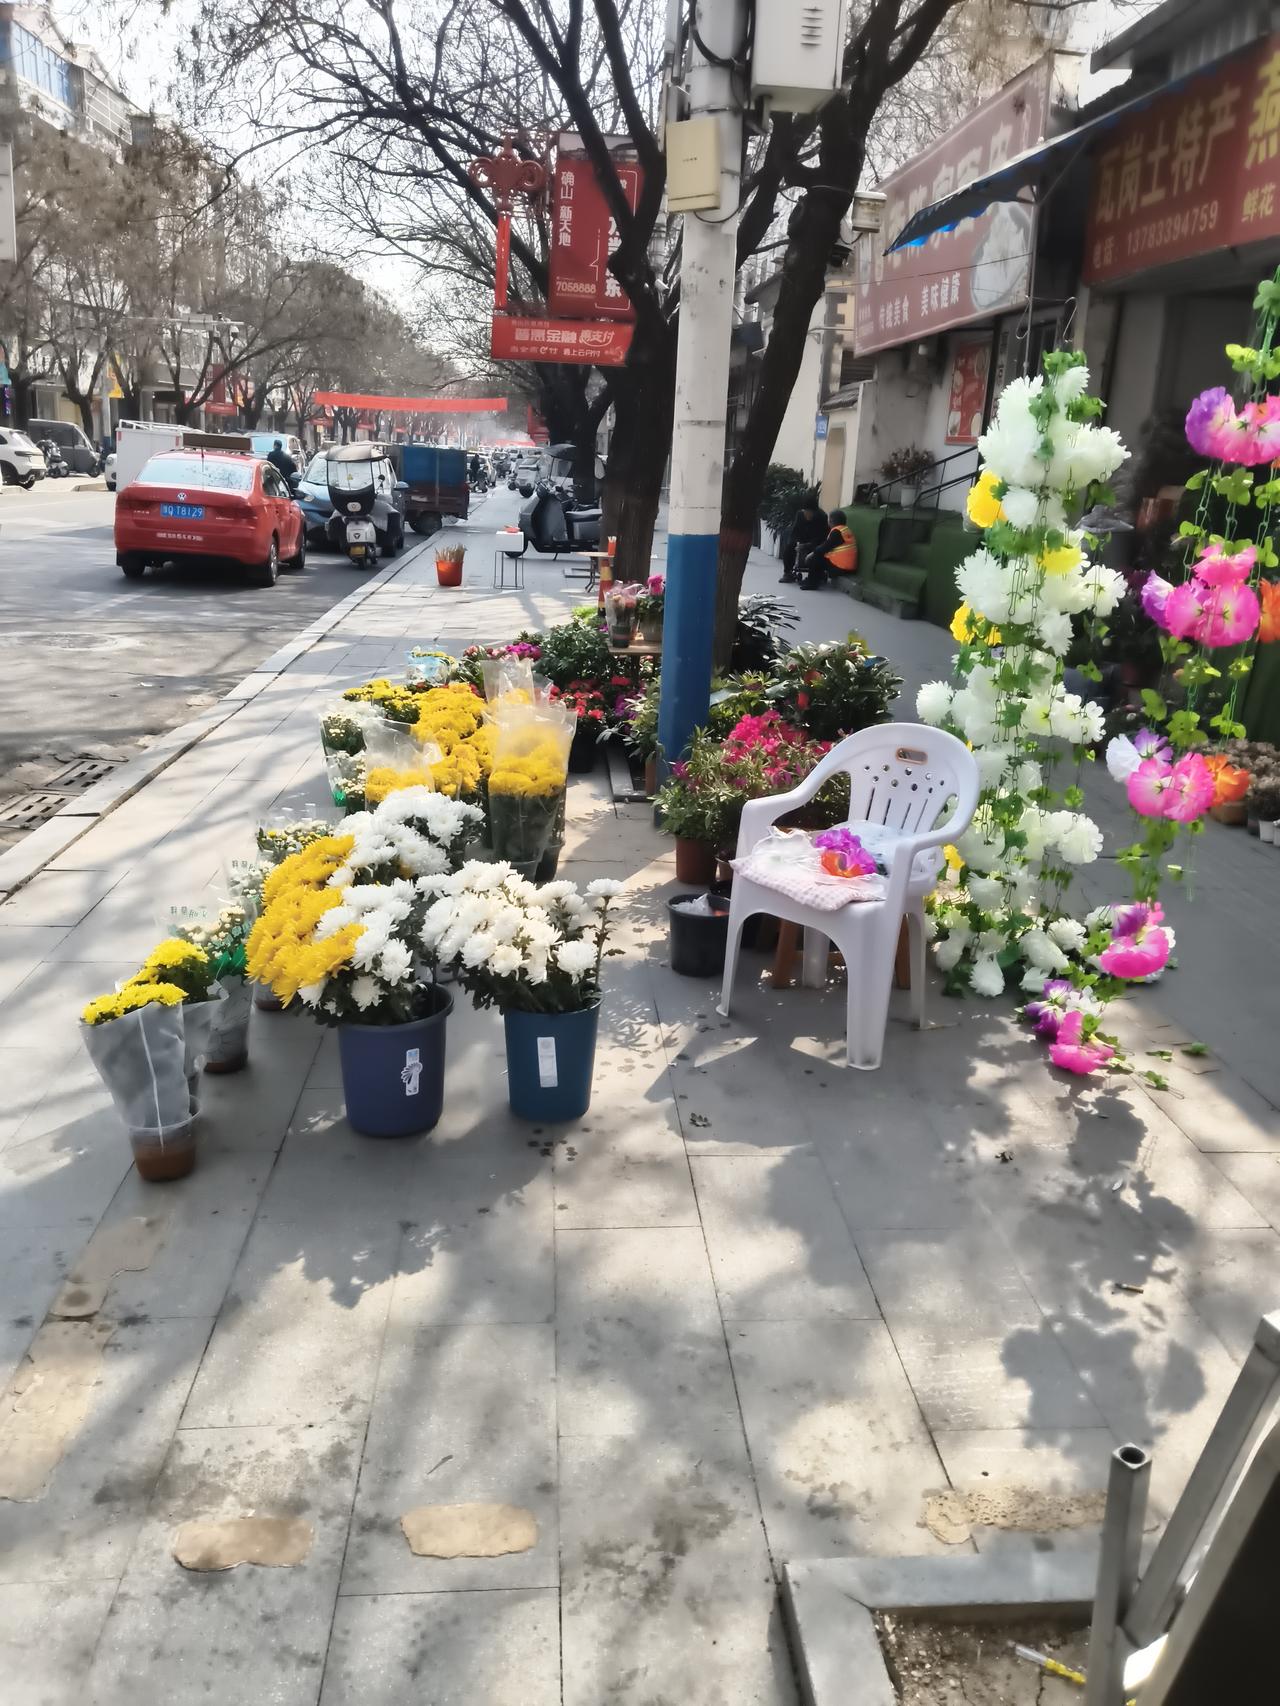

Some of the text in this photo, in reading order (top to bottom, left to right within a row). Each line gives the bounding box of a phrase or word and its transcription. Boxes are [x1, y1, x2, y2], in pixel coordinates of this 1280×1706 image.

[1096, 82, 1241, 225] 瓦岗土特产
[1127, 200, 1219, 256] 13783394759
[921, 271, 961, 318] 美味健康
